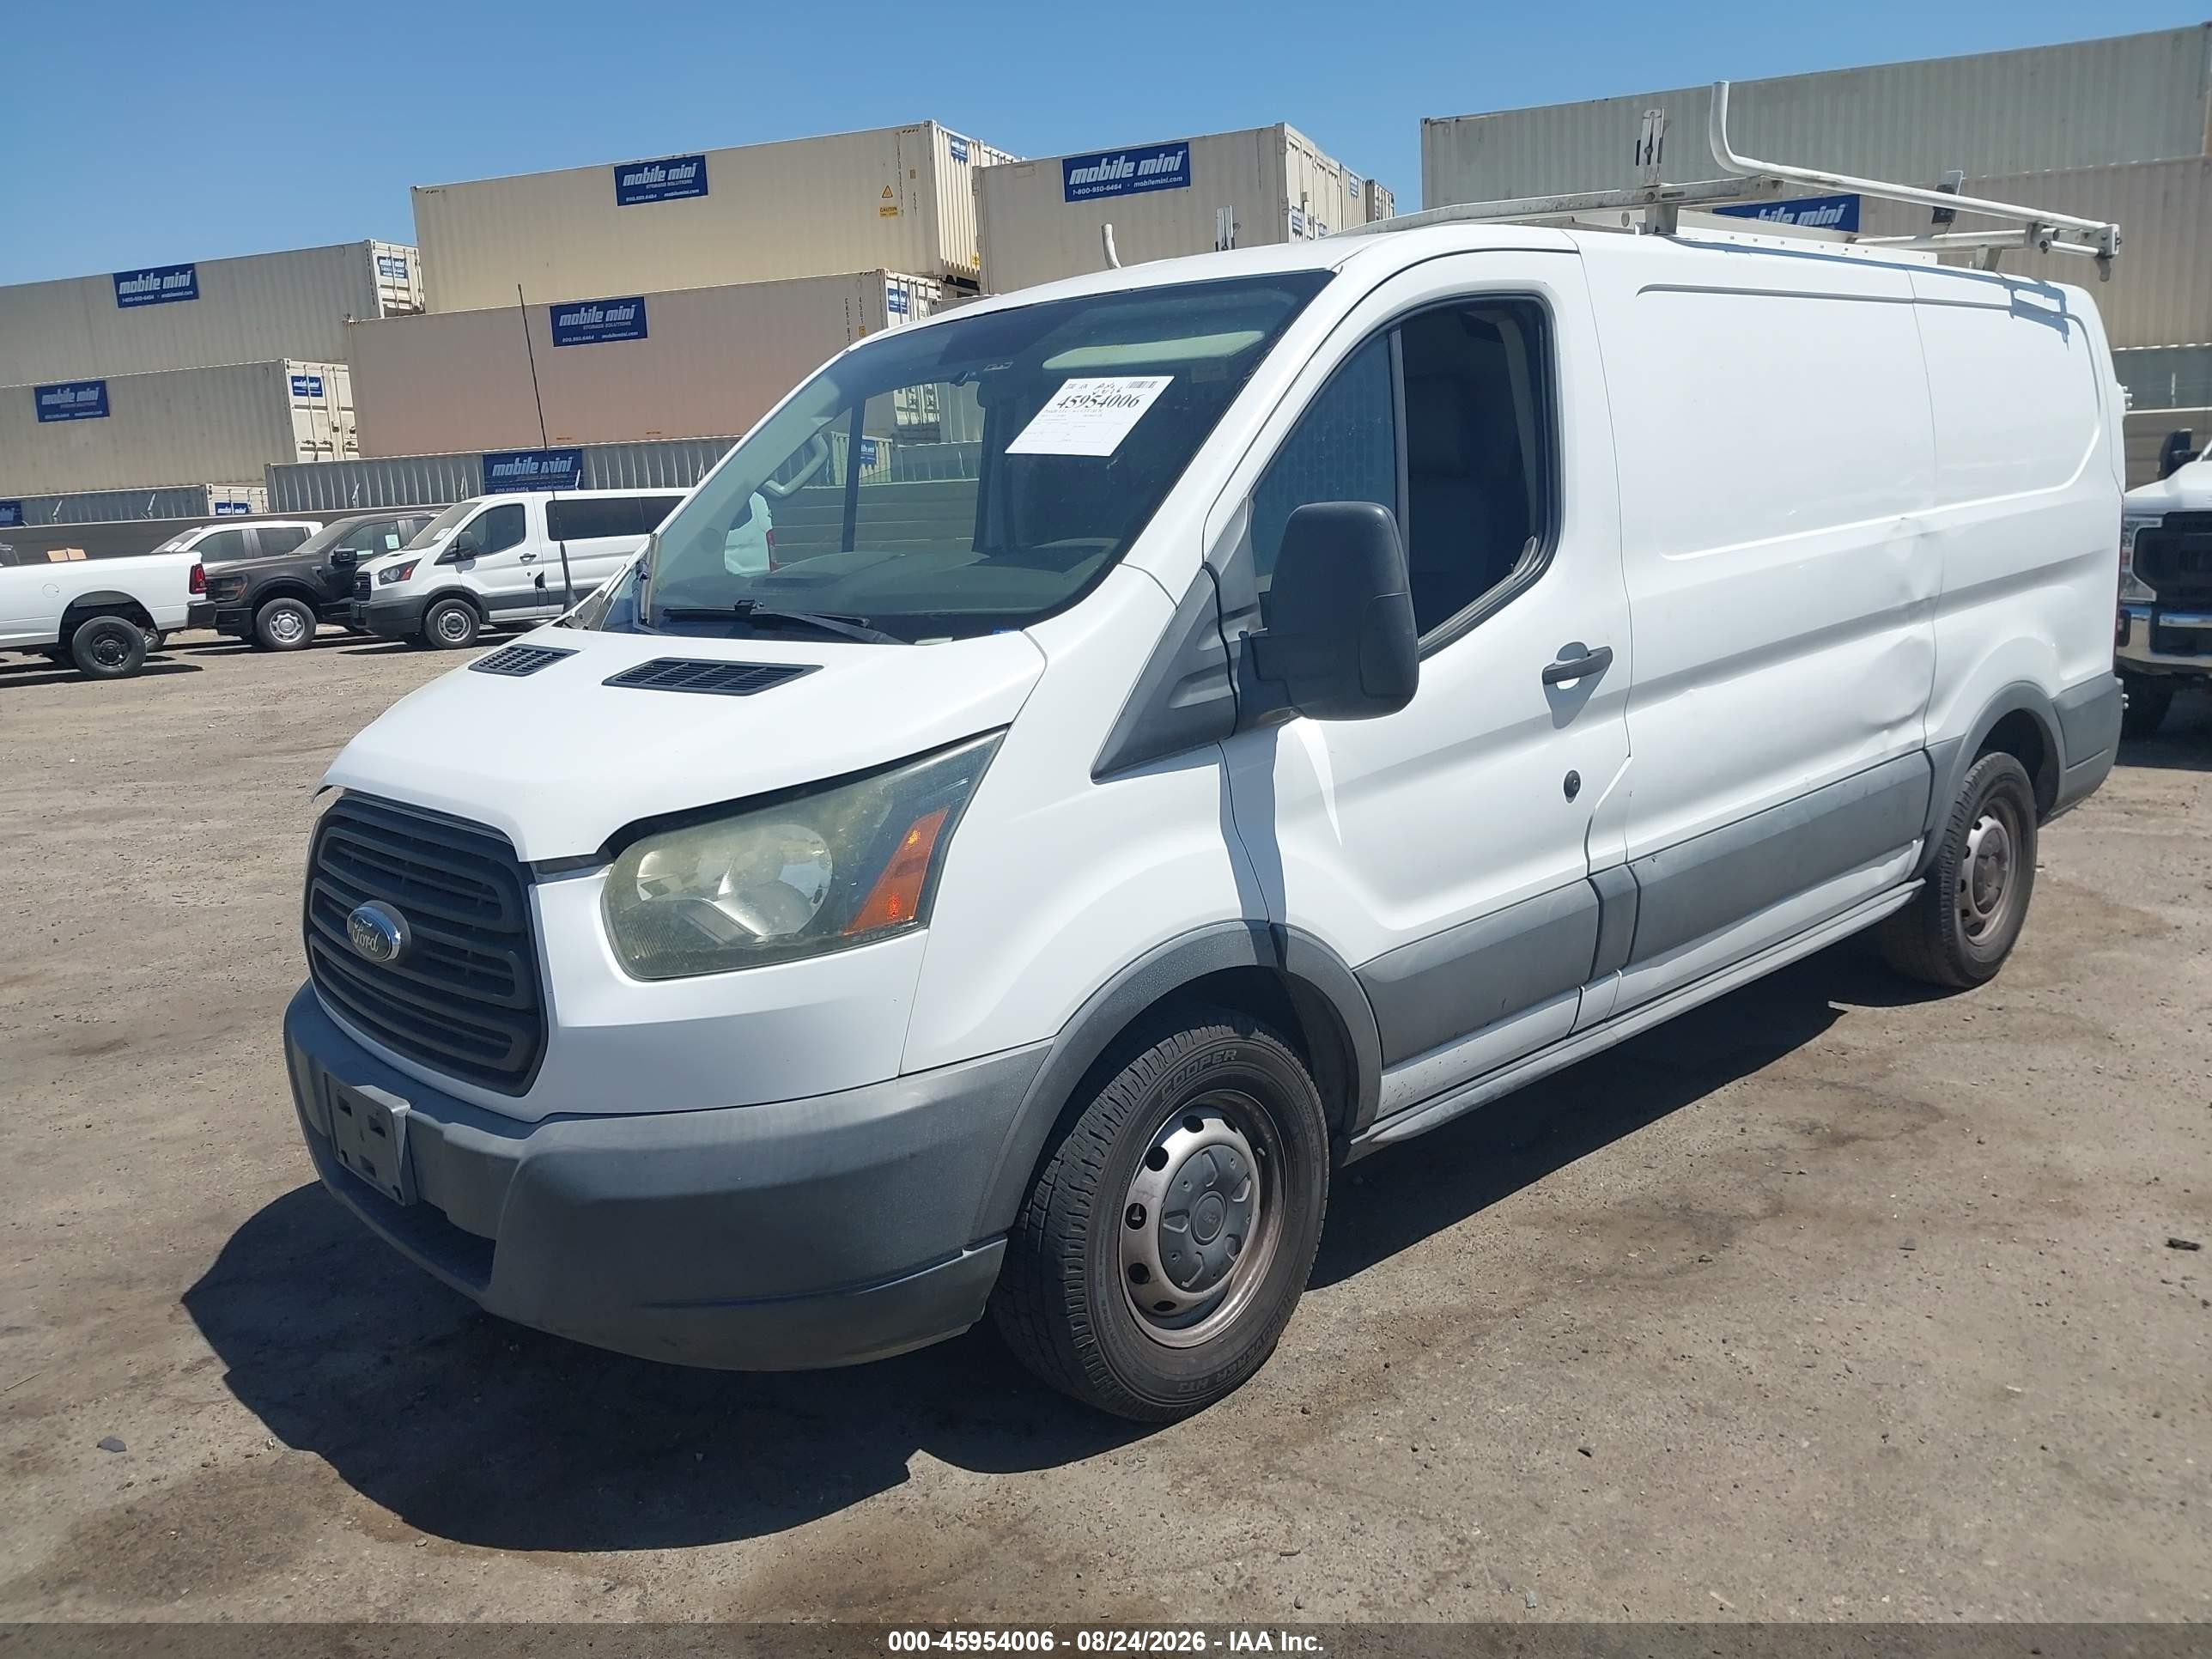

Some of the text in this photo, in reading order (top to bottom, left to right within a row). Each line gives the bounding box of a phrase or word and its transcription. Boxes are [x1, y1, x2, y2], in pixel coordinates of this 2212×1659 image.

[623, 162, 697, 186] mobile mini
[1069, 150, 1183, 185] mobile mini
[1133, 176, 1183, 188] mobilemini.com
[1750, 204, 1846, 226] bile mini
[118, 270, 192, 295] mobile mini
[559, 304, 636, 326] mobile mini
[41, 388, 76, 405] mobile
[76, 386, 100, 402] mini
[1057, 394, 1146, 409] 45954006
[492, 456, 573, 477] mobile mini
[352, 916, 380, 952] Ford
[1160, 1048, 1238, 1101] COOPER
